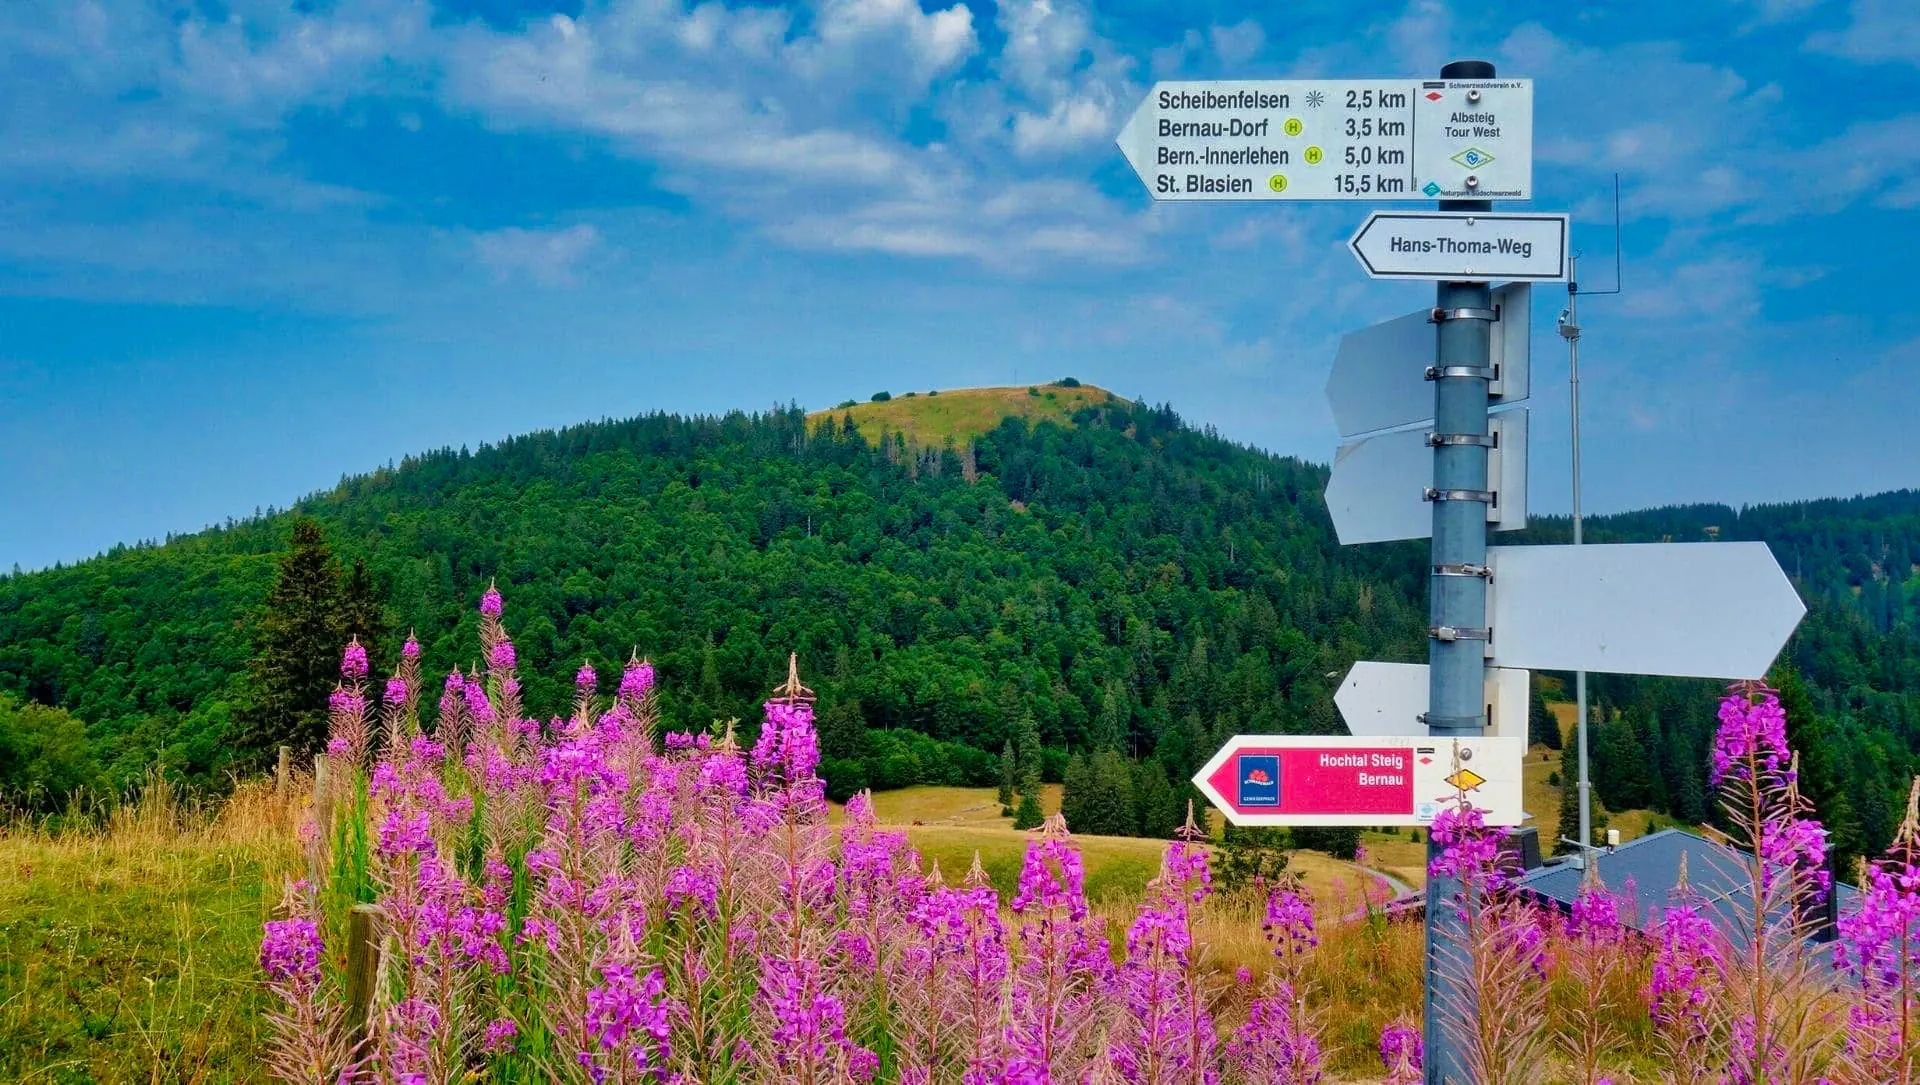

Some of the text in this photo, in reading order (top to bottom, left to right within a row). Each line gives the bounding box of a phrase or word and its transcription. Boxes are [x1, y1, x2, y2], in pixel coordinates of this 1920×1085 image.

[1159, 89, 1406, 112] Scheibenfelsen 2,5 km
[1158, 118, 1268, 137] Bernau-Dorf
[1345, 118, 1372, 140] 3,5
[1378, 117, 1405, 137] km
[1450, 112, 1495, 125] Albsteig
[1445, 126, 1500, 137] Tour West
[1157, 146, 1289, 165] Bern.-Innerlehen
[1345, 146, 1372, 168] 5,0
[1377, 145, 1405, 165] km
[1157, 174, 1180, 193] St.
[1186, 174, 1252, 193] Blasien
[1334, 174, 1371, 196] 15,5
[1376, 173, 1404, 193] km
[1390, 236, 1532, 258] Hans-Thoma-Weg
[1320, 753, 1403, 769] Hochtal Steig
[1358, 772, 1404, 786] Bernau
